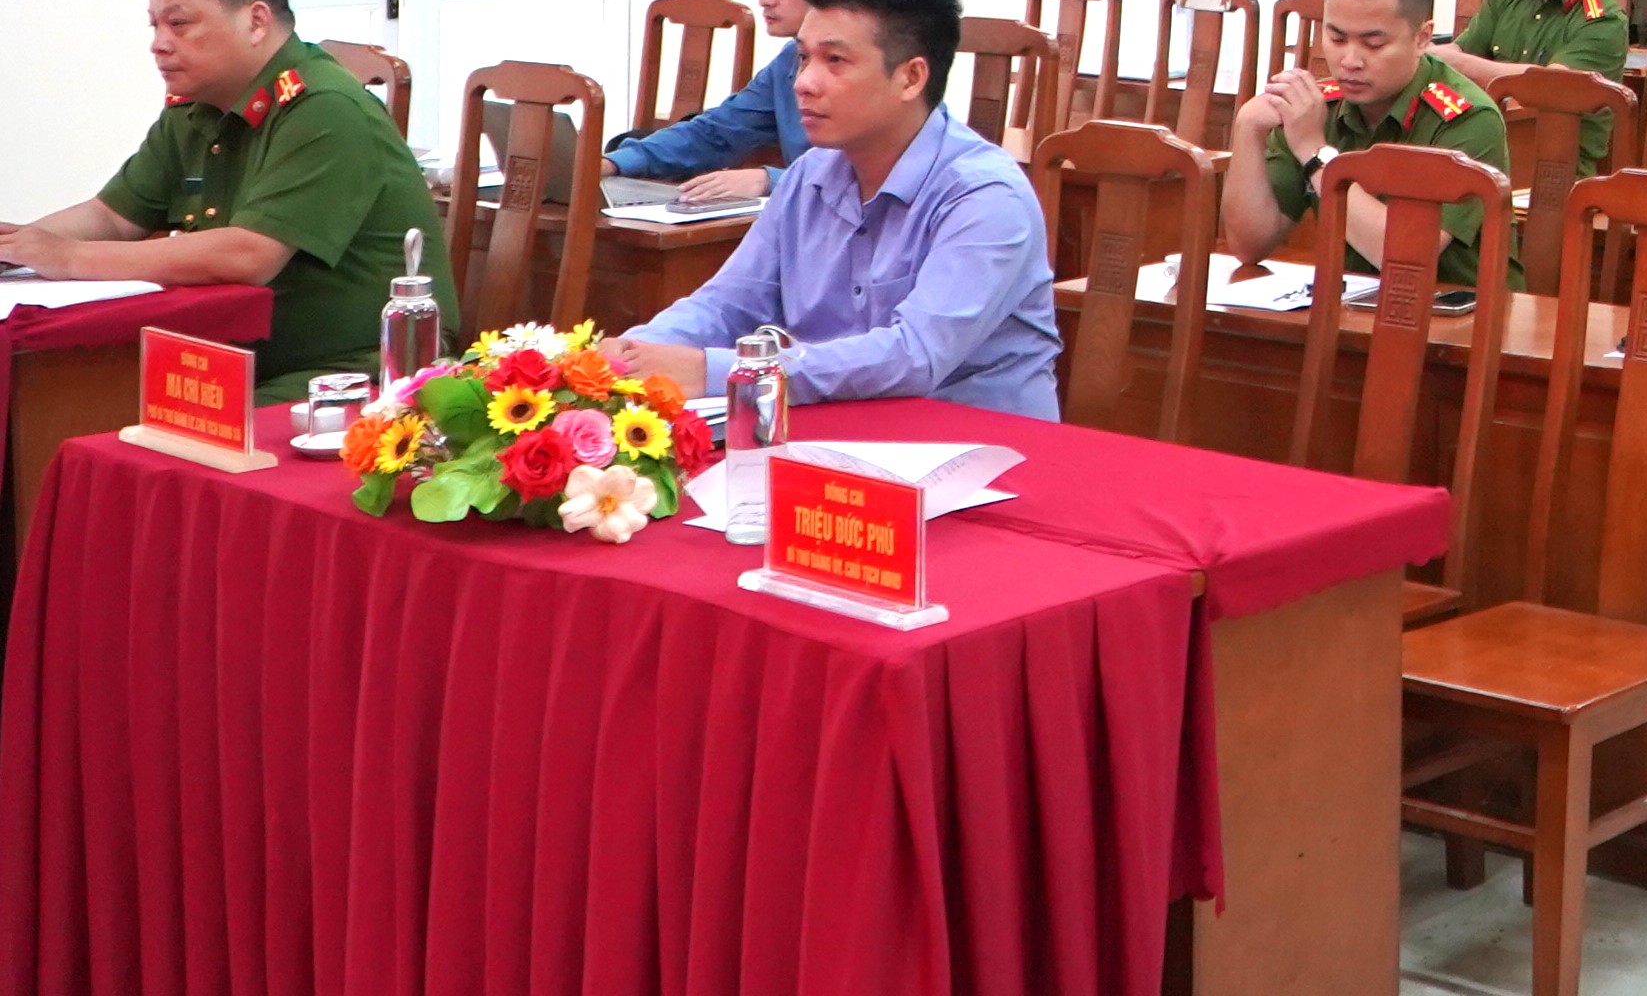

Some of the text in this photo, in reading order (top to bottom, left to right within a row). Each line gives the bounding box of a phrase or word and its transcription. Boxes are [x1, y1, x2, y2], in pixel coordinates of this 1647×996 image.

[166, 373, 182, 399] MA
[794, 504, 895, 556] TRIỆU ĐỨC PHÚ
